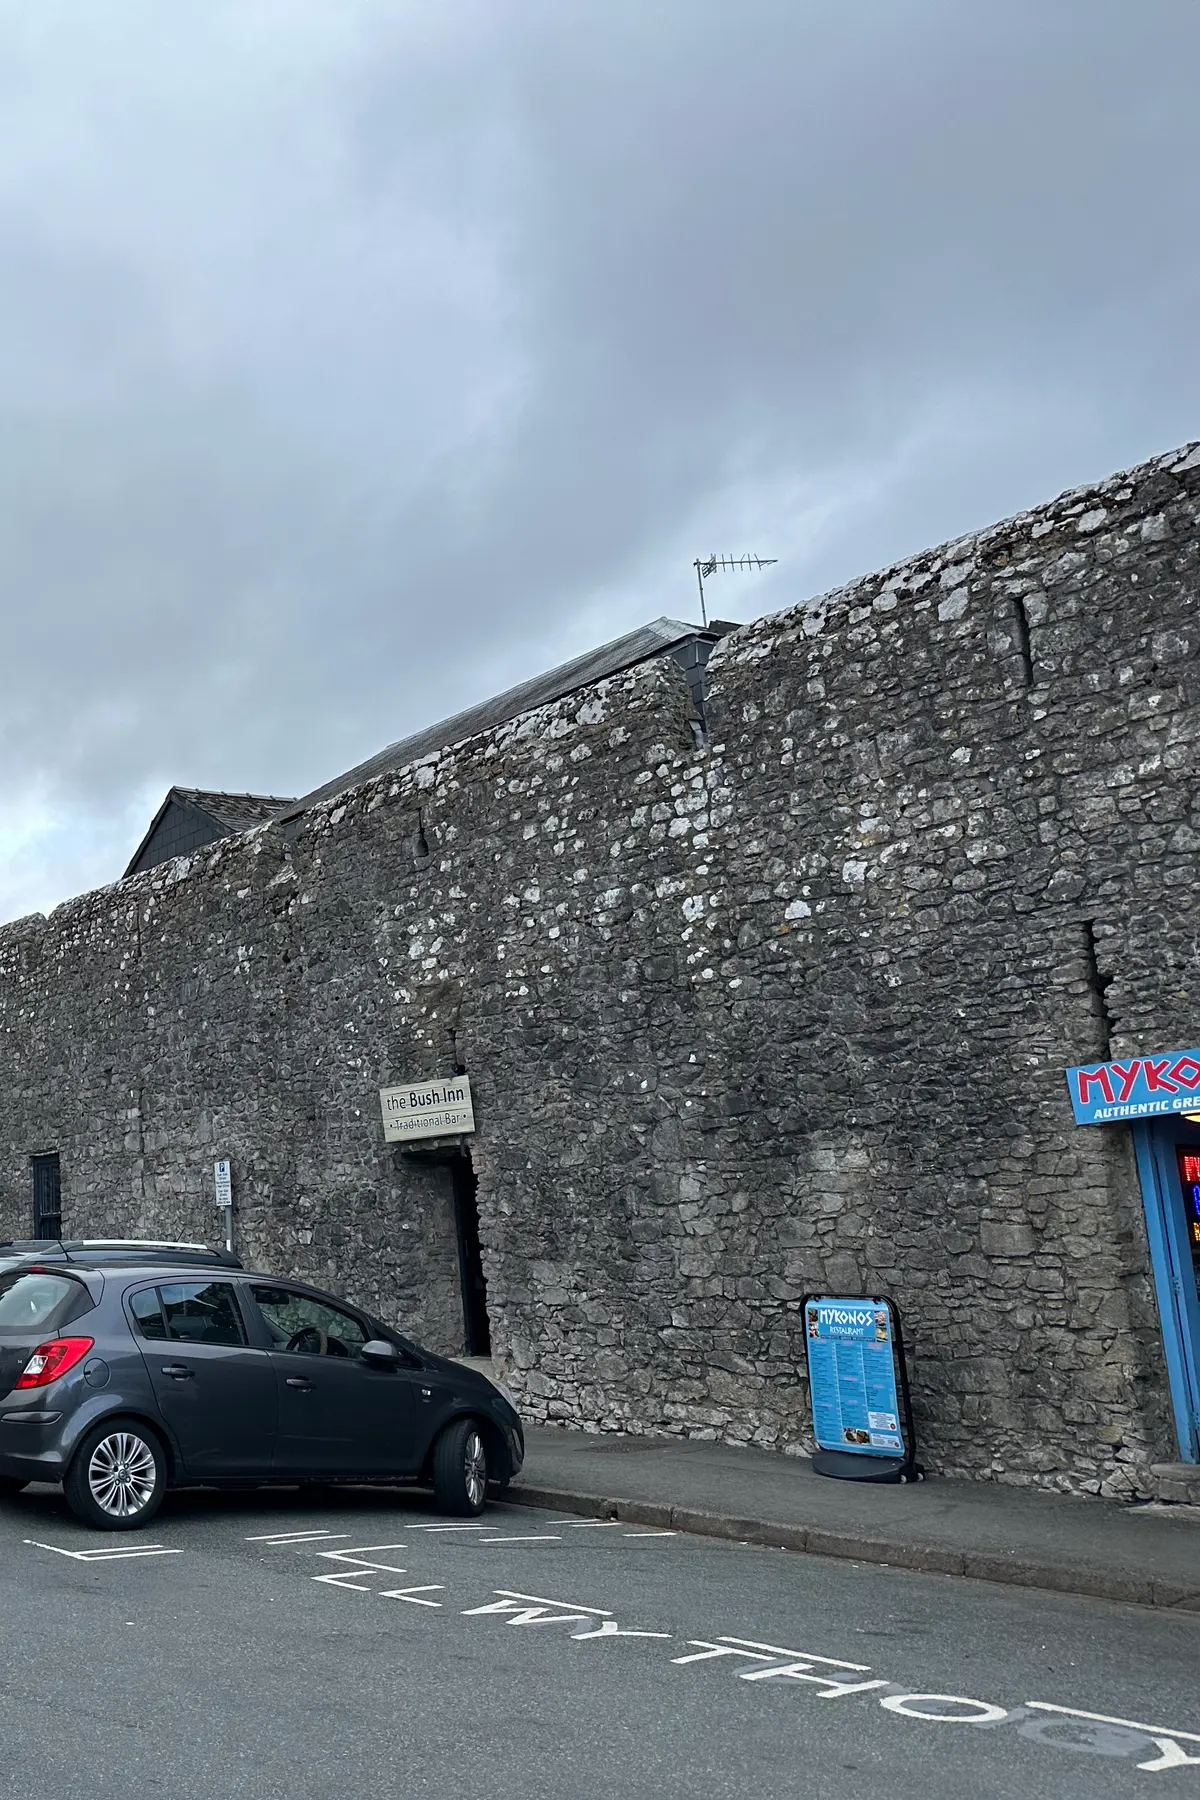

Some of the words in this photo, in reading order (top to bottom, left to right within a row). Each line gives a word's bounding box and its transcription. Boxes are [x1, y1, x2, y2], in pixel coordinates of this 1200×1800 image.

[386, 1096, 406, 1111] the
[409, 1089, 440, 1108] Bush
[443, 1087, 464, 1103] Inn
[1093, 1100, 1169, 1119] AUTHENTIC
[395, 1115, 443, 1130] Traditional
[445, 1112, 460, 1125] Bar
[820, 1309, 873, 1326] MYKONOS
[829, 1326, 864, 1336] RESTAURANT
